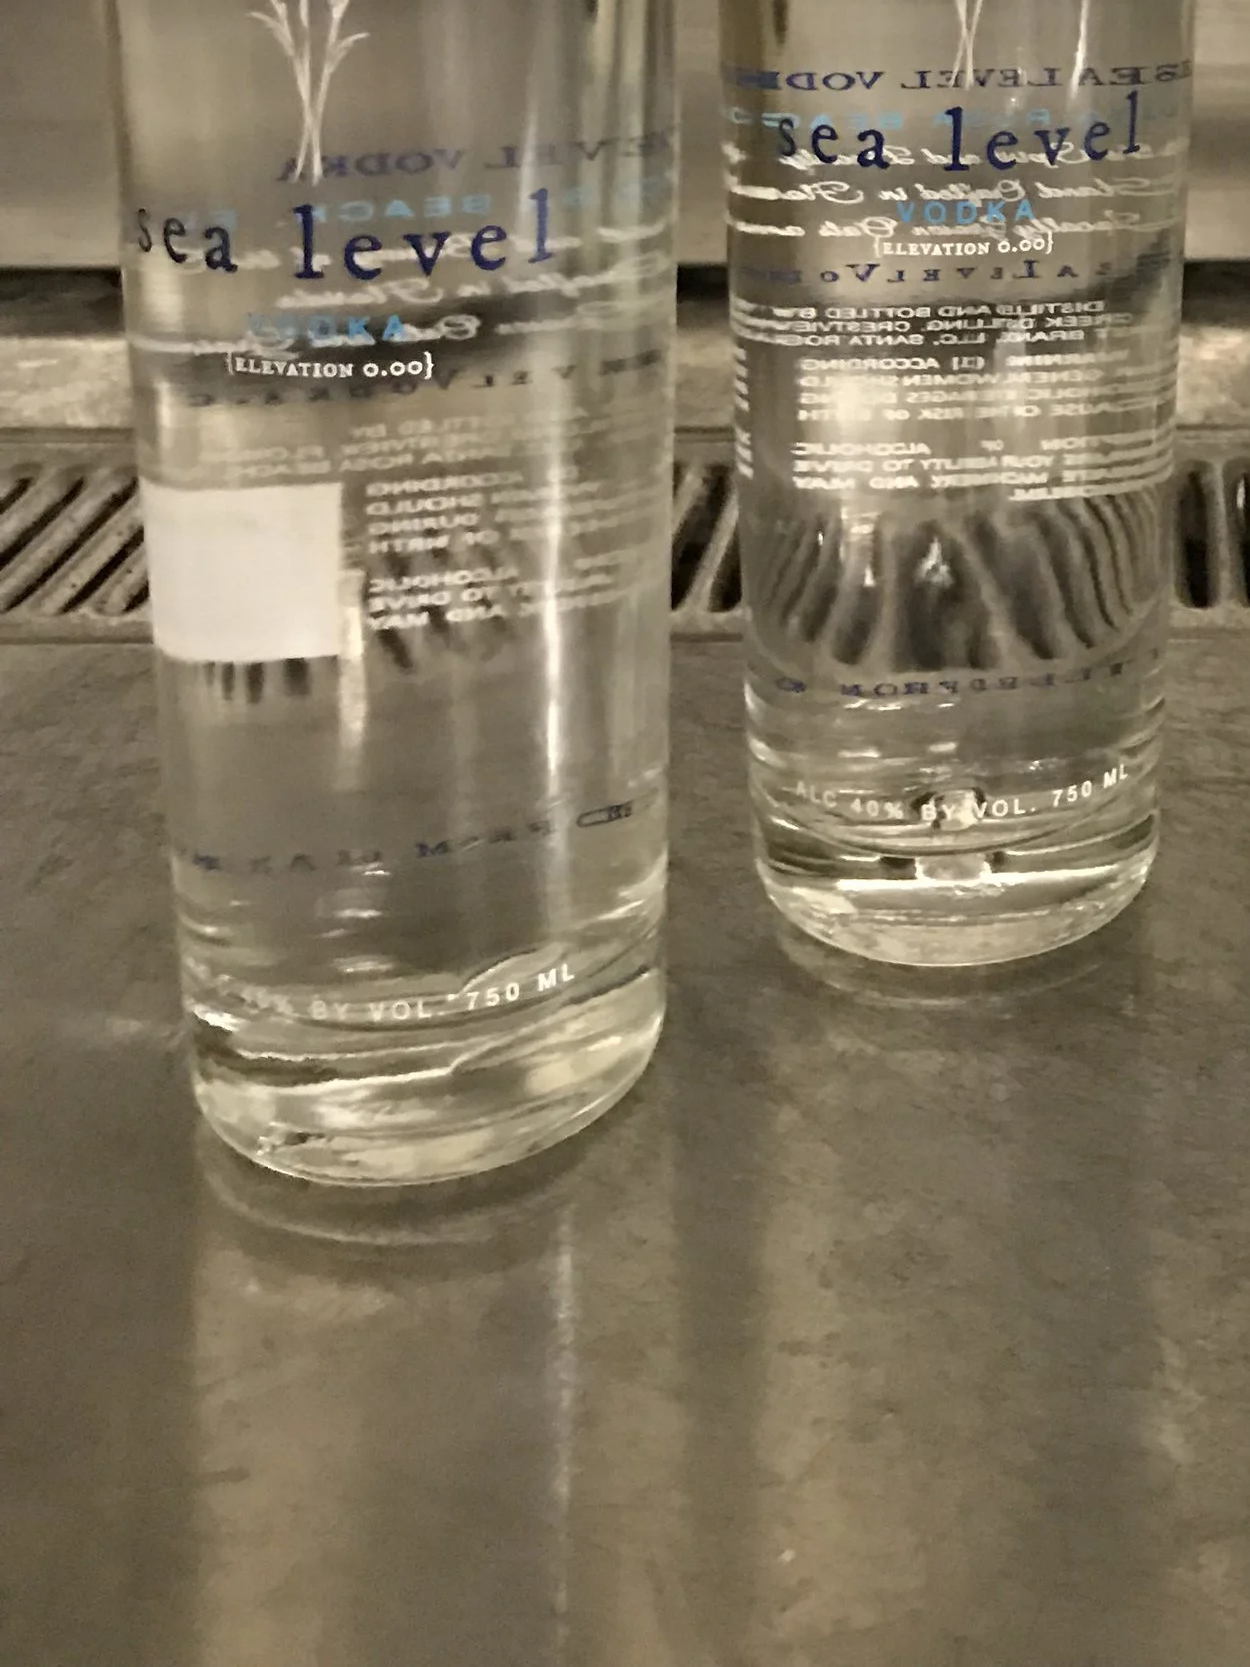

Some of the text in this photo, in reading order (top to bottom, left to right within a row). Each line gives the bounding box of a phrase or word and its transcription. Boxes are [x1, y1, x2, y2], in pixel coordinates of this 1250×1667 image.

[777, 117, 891, 170] sea
[942, 91, 1141, 172] level
[135, 207, 240, 273] sea
[291, 187, 556, 280] level
[896, 198, 1038, 225] VODKA
[850, 797, 904, 821] 40%
[920, 802, 956, 823] BY
[970, 795, 1037, 820] VOL.
[1051, 780, 1094, 807] 750
[1102, 763, 1131, 789] ML
[309, 998, 350, 1021] BY
[466, 982, 521, 1013] 750
[536, 962, 577, 993] ML
